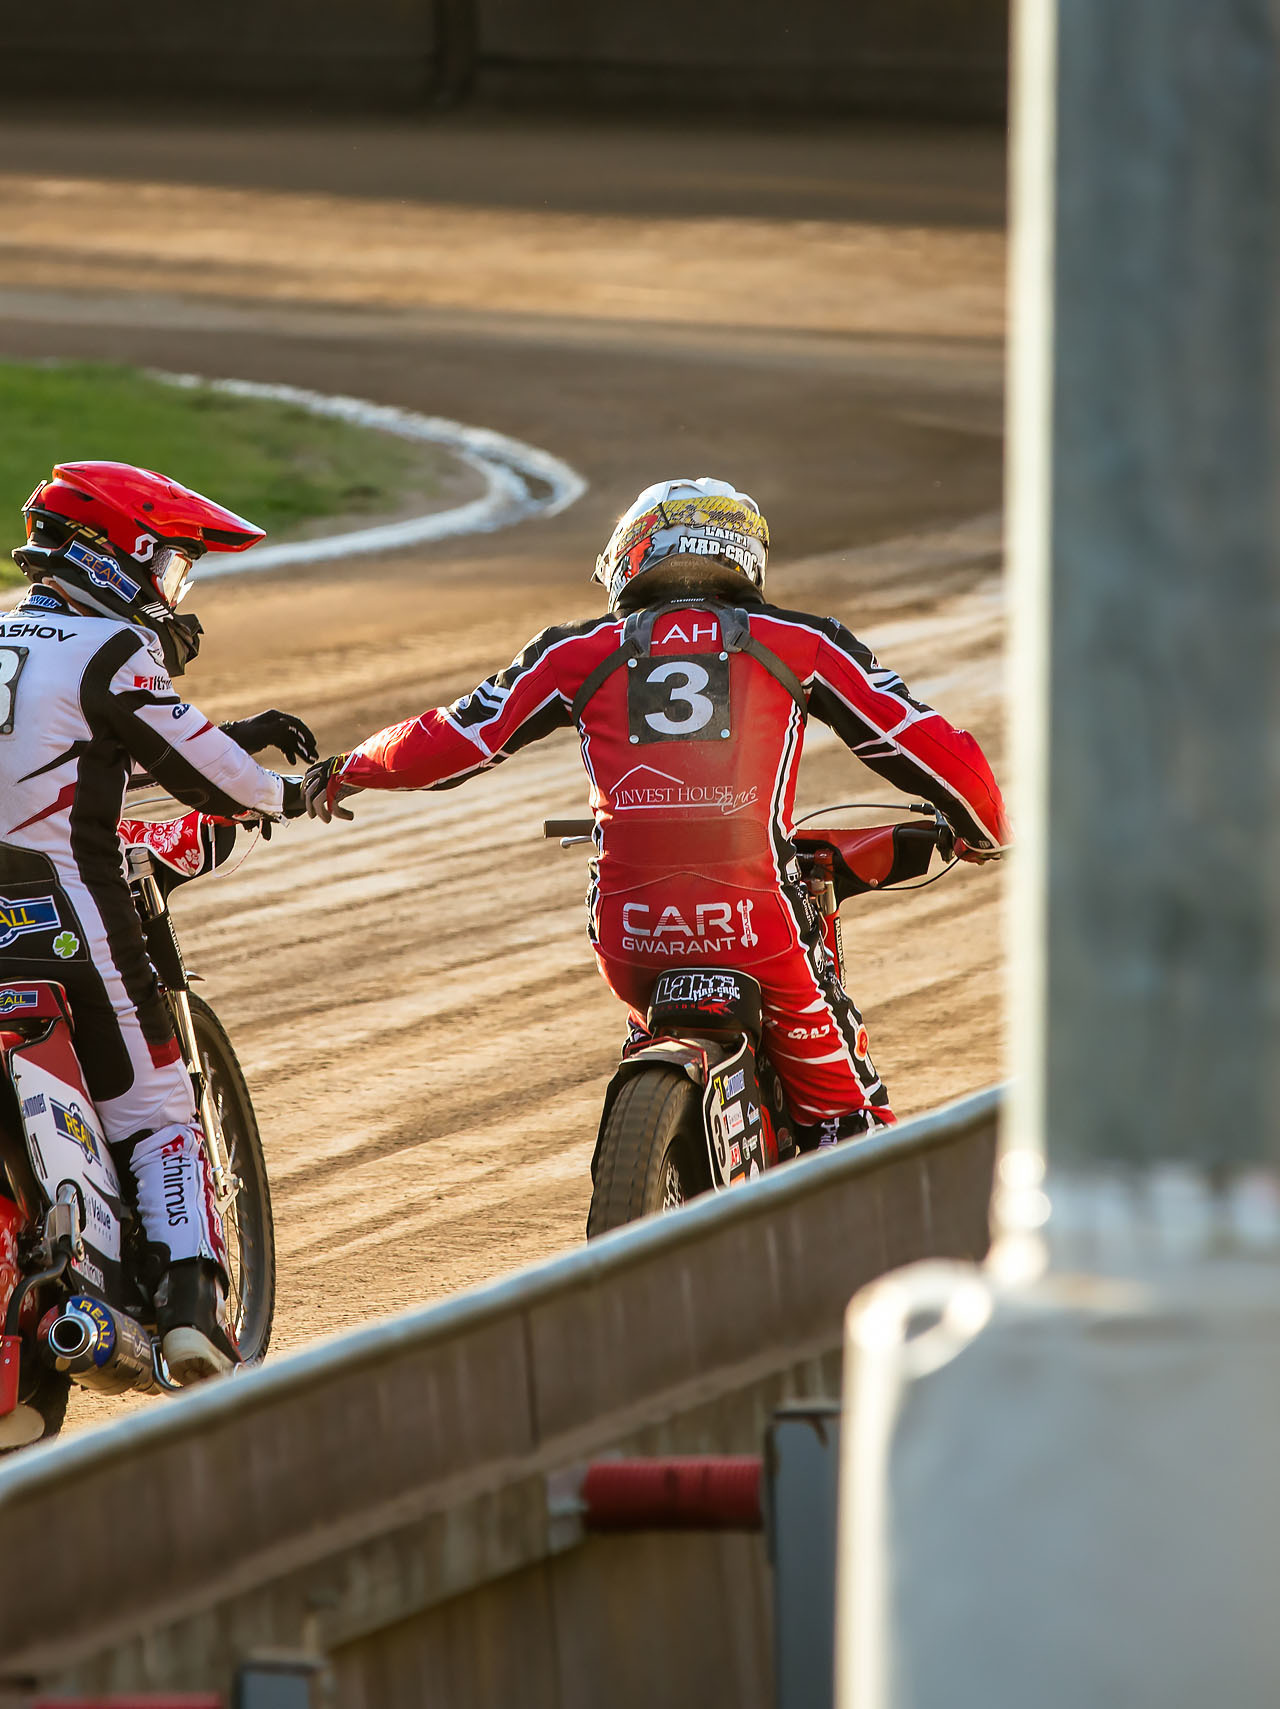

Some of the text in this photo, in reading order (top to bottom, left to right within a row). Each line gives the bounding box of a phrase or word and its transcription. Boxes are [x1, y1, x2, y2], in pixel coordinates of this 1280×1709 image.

[81, 553, 124, 589] REALL
[679, 536, 758, 583] MAD-CROC
[644, 661, 714, 735] 3
[622, 788, 674, 805] INVEST
[678, 785, 734, 802] HOUSE
[623, 902, 735, 937] CAR
[622, 936, 736, 955] GWARANT
[63, 1112, 96, 1155] REALL
[80, 1300, 110, 1351] REALL
